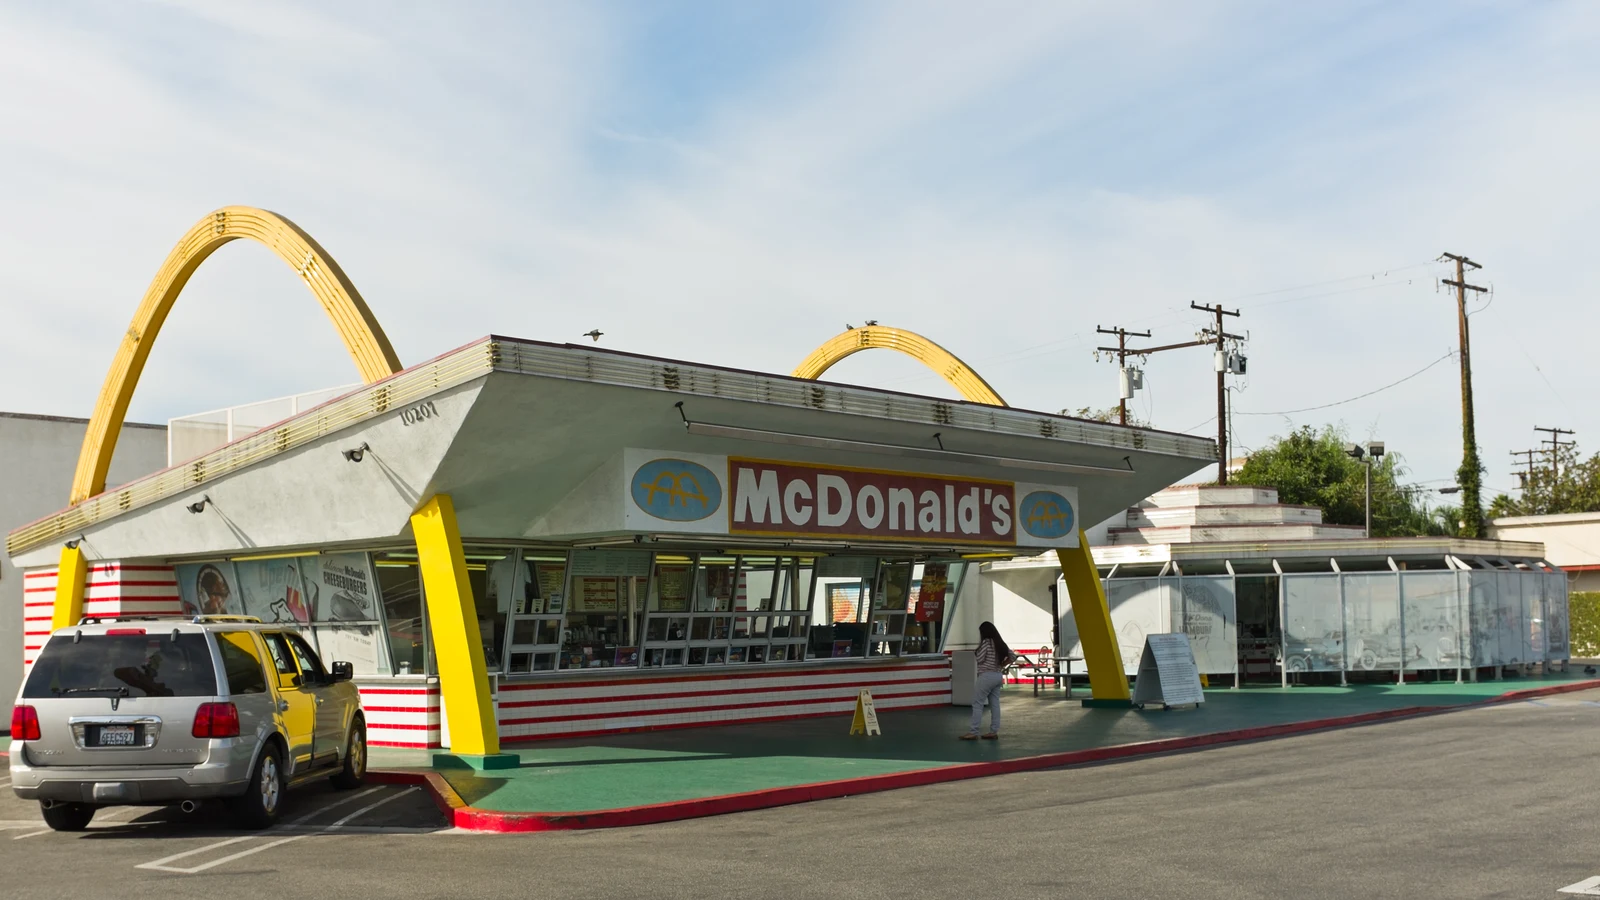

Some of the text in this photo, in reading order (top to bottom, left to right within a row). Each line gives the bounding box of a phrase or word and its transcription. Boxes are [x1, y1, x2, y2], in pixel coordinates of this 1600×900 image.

[399, 401, 440, 427] 10207
[733, 467, 1012, 536] McDonald's
[323, 571, 368, 596] CHEESEBURGERS
